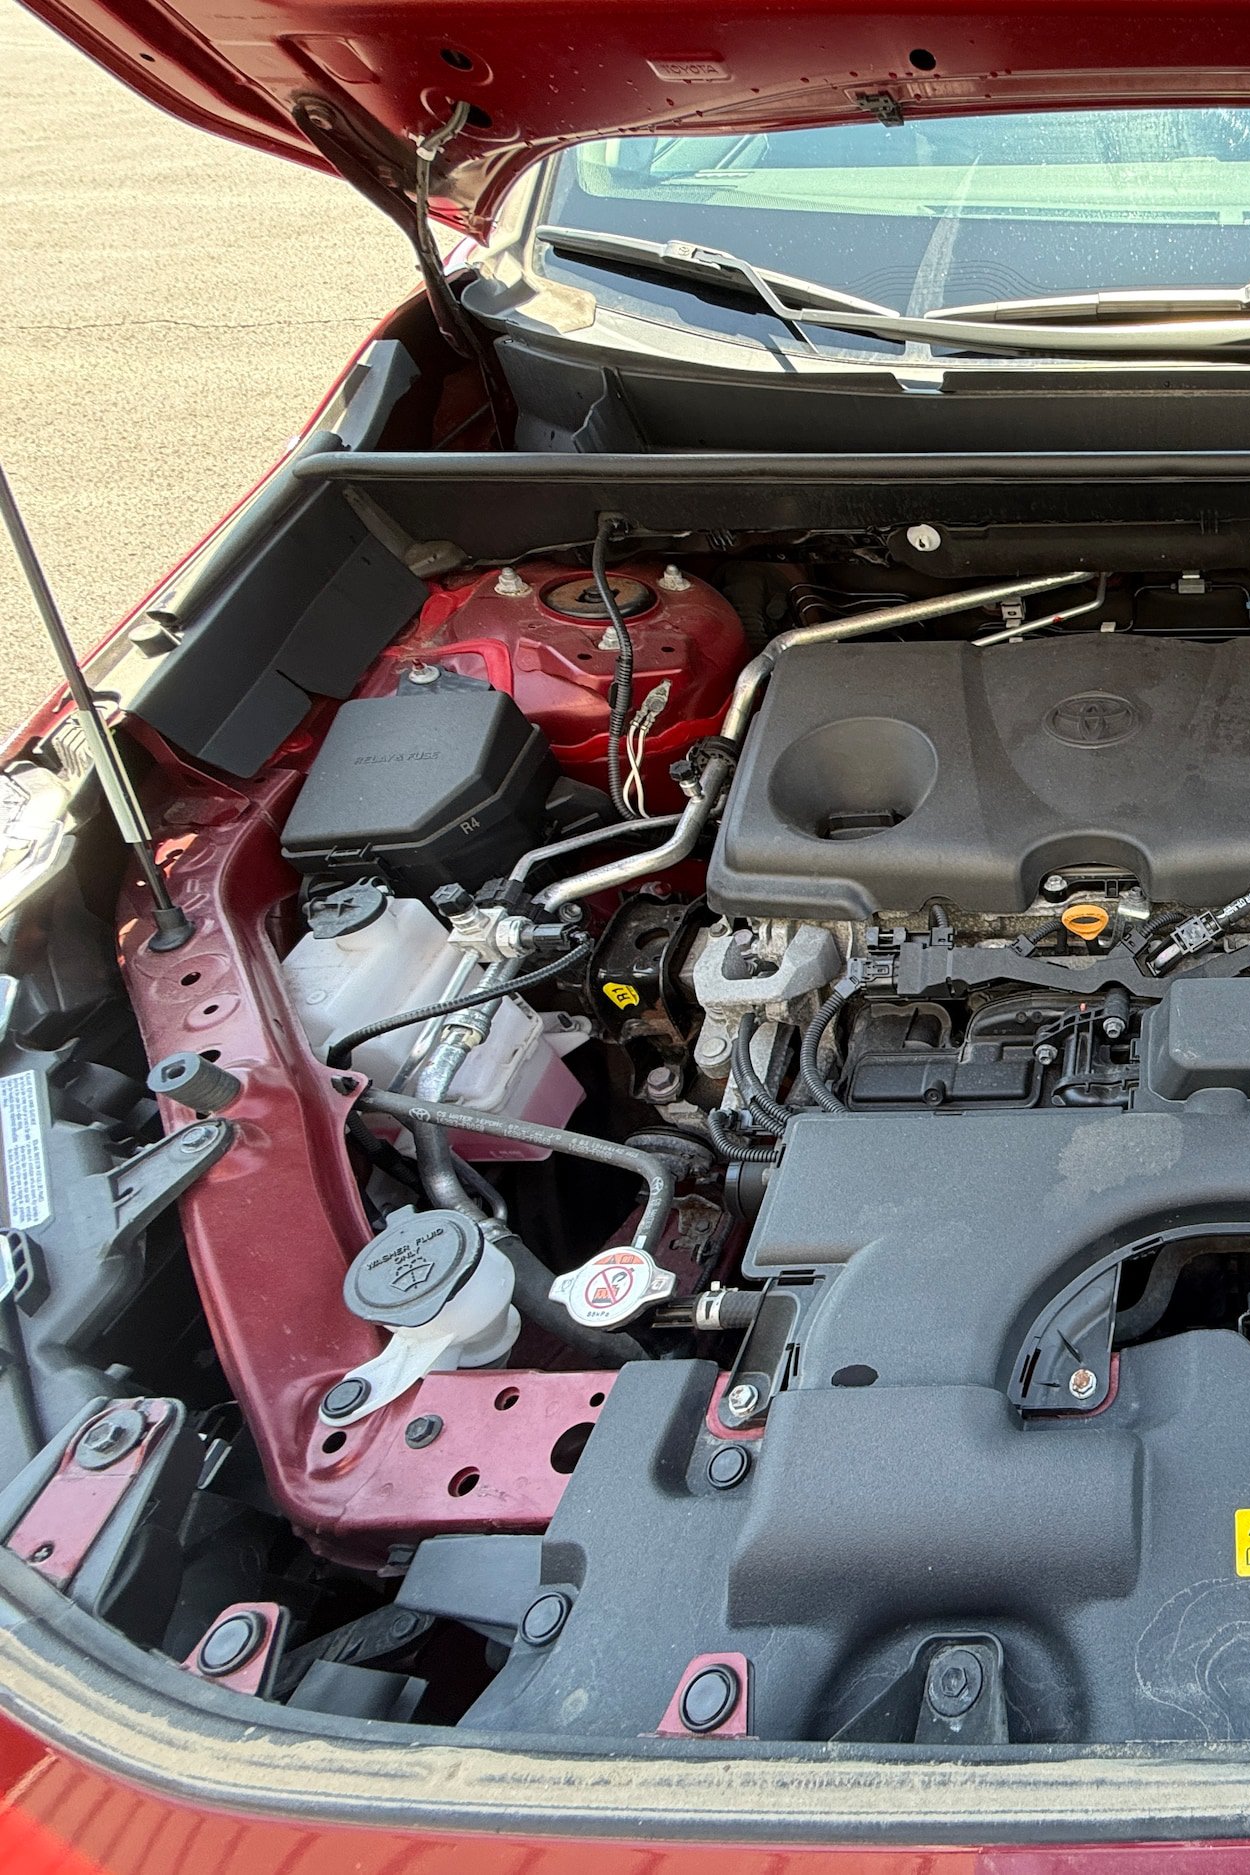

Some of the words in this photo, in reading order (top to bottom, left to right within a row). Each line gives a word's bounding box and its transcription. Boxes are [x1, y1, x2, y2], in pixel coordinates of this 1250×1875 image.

[661, 64, 719, 75] TOYOTA
[354, 754, 396, 765] RELAY
[406, 751, 441, 761] FUSE
[460, 816, 481, 835] R4
[611, 987, 631, 1003] R1
[367, 1244, 411, 1271] WASHER
[415, 1227, 444, 1247] FLUID
[394, 1246, 421, 1265] ONLY
